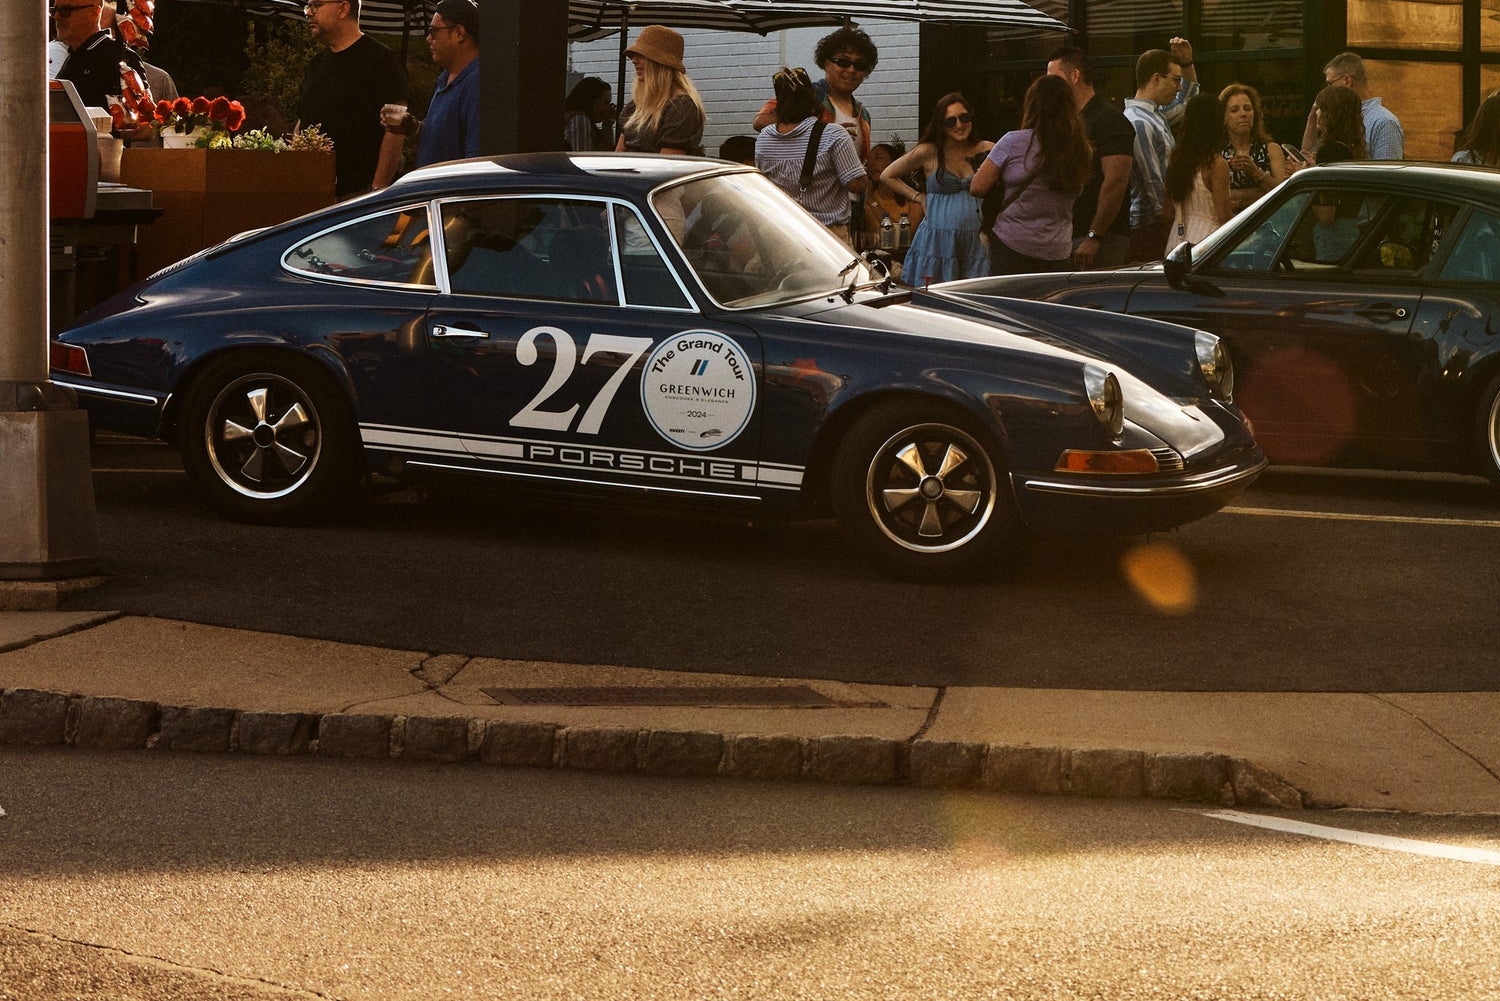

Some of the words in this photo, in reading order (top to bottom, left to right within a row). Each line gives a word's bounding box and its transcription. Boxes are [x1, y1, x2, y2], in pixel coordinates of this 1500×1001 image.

[652, 349, 675, 374] The
[677, 339, 724, 354] Grand
[724, 348, 744, 381] Tour
[509, 326, 654, 435] 27
[659, 383, 735, 399] GREENWICH
[687, 410, 707, 418] 2024
[530, 445, 736, 478] PORSCHE
